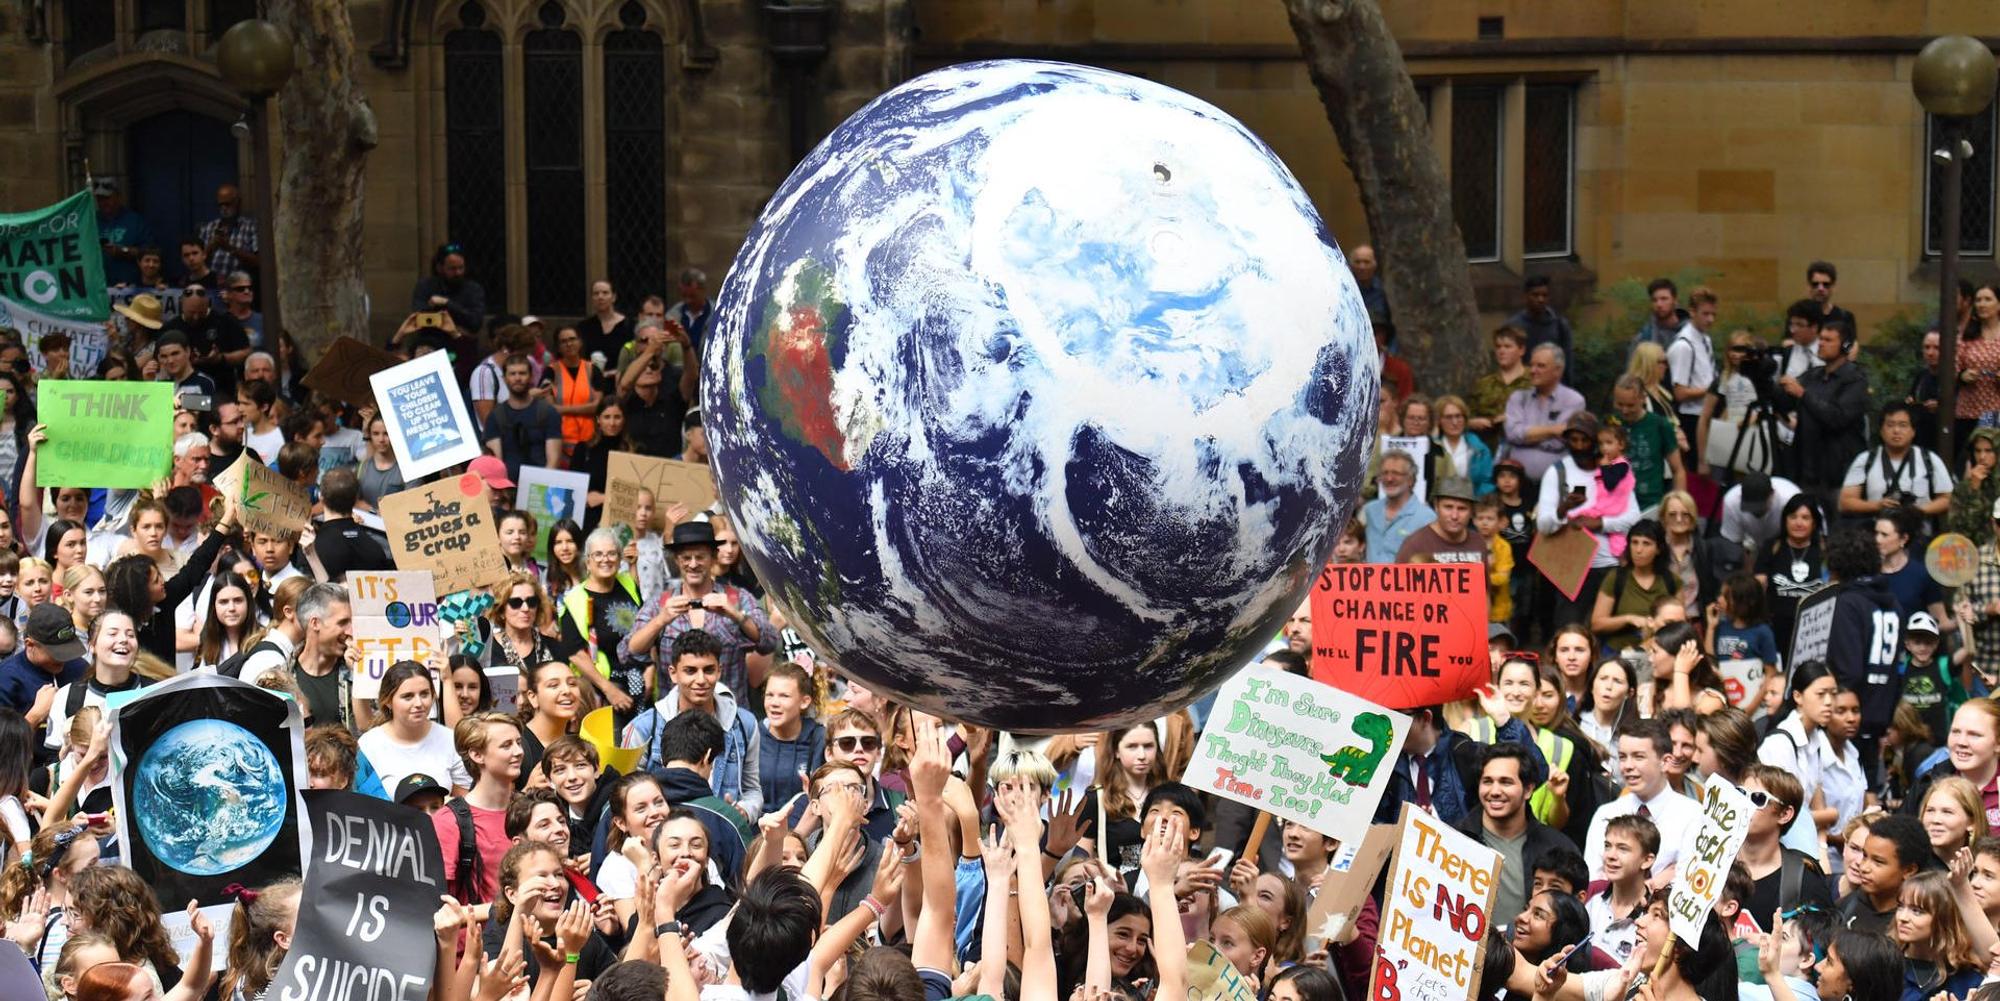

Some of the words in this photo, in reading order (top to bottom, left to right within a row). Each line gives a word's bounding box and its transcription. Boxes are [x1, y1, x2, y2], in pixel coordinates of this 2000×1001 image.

[38, 212, 79, 233] FOR
[391, 385, 410, 398] YOU
[410, 375, 435, 388] LEAVE
[414, 400, 441, 416] CLEAN
[466, 512, 481, 526] a
[423, 532, 471, 556] crap
[355, 575, 398, 601] IT'S
[1320, 566, 1374, 592] STOP
[1380, 566, 1470, 593] CLIMATE
[1333, 598, 1415, 621] CHANGE
[1423, 603, 1448, 623] OR
[1356, 628, 1440, 677] FIRE
[1448, 655, 1473, 665] YOU
[1869, 609, 1900, 665] 19
[1241, 677, 1290, 707] I'm
[1293, 692, 1341, 723] Sure
[1224, 700, 1324, 758] Dinosaurs
[1213, 766, 1264, 800] Time
[1269, 785, 1323, 819] Too!
[1269, 753, 1313, 795] They
[1310, 771, 1355, 806] Had
[324, 811, 436, 886] DENIAL
[1413, 818, 1491, 896] There
[345, 891, 390, 943] IS
[1402, 868, 1431, 909] IS
[1433, 883, 1486, 942] NO
[1389, 908, 1470, 988] Planet
